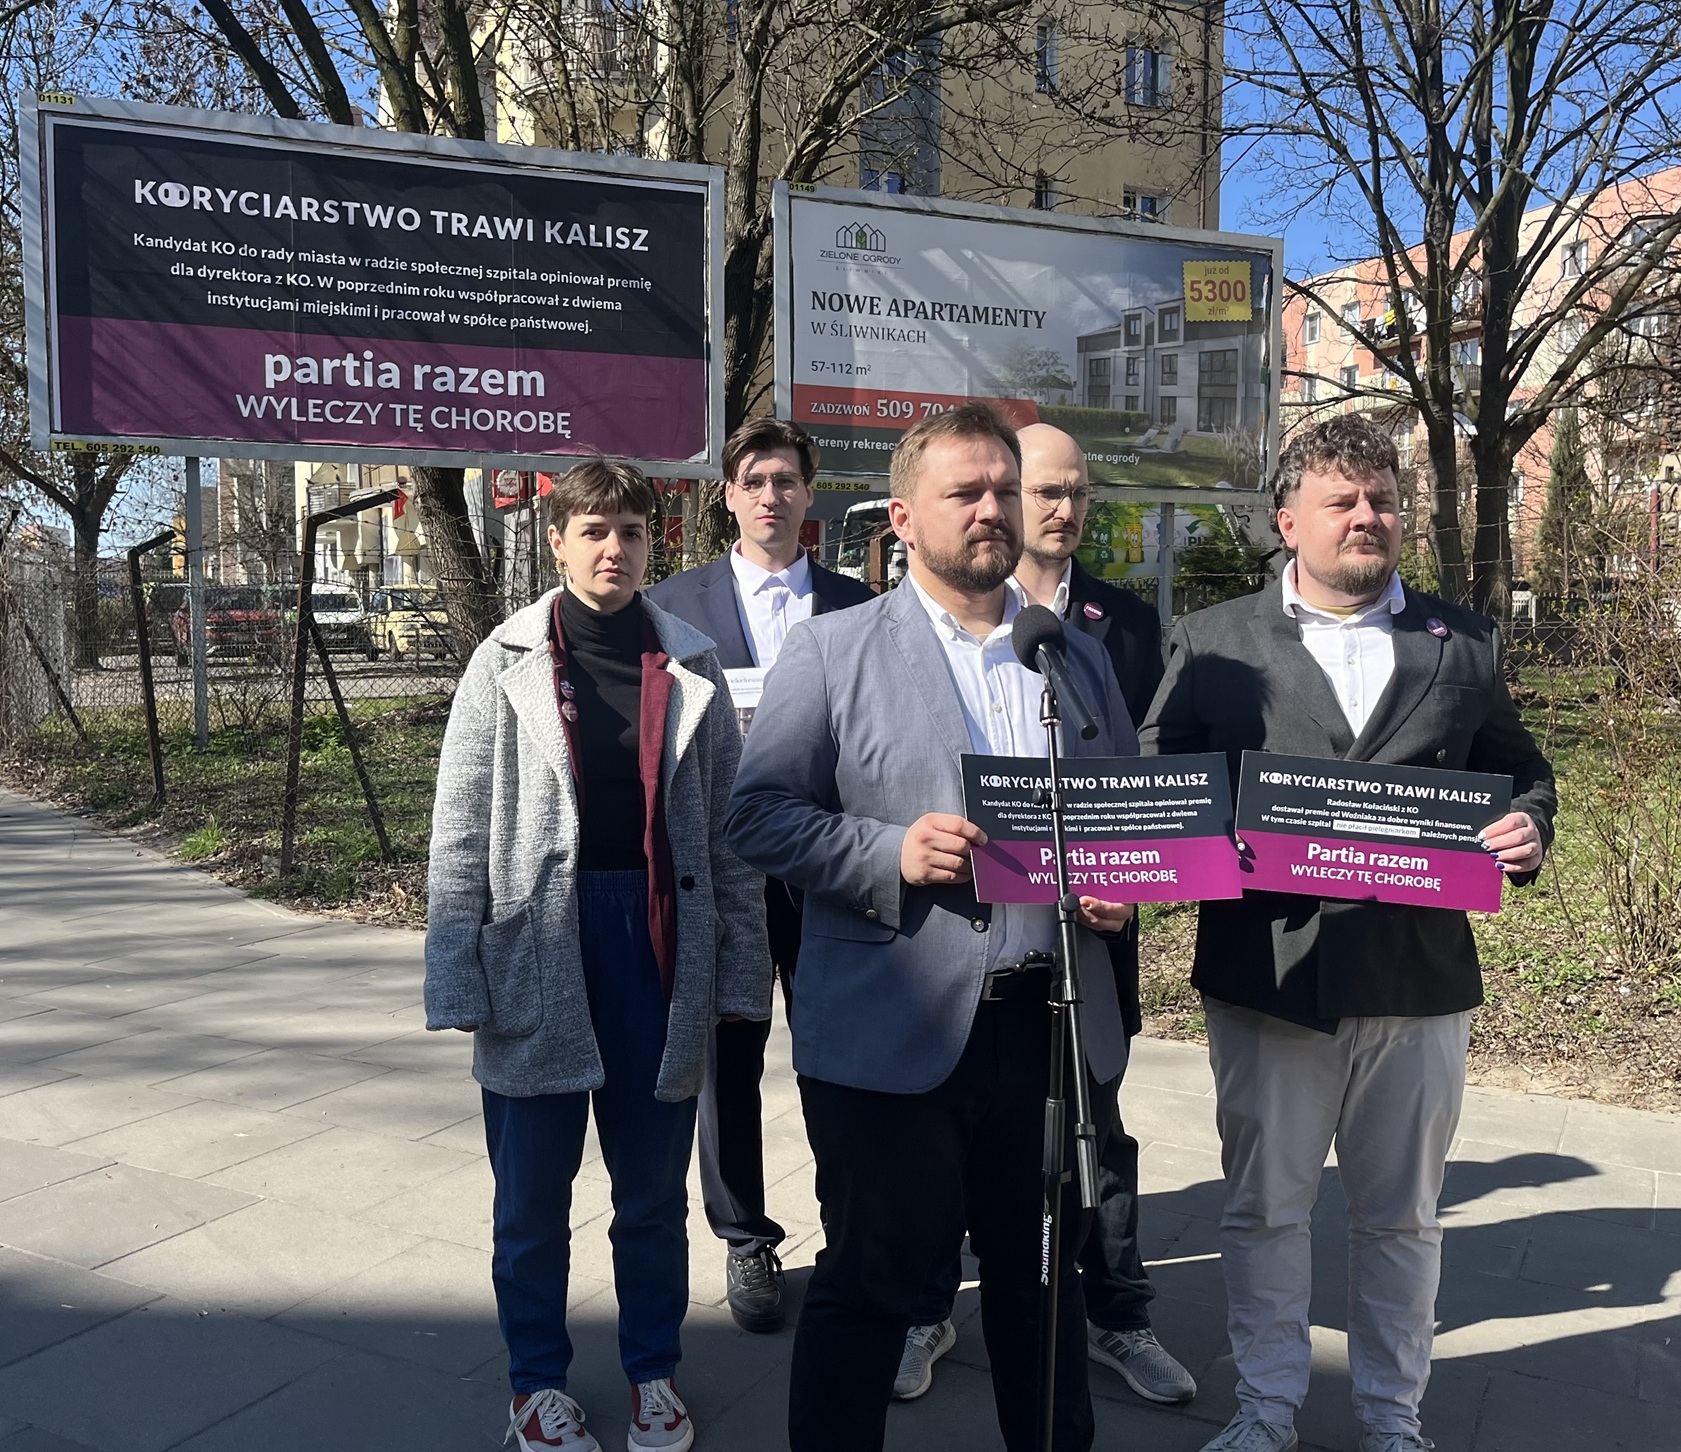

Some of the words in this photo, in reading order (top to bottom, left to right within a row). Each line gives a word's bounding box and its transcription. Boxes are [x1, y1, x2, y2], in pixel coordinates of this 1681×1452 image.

[38, 94, 75, 105] 01131
[789, 183, 815, 193] 01149
[430, 210, 534, 241] TRAWI
[544, 221, 650, 252] KALISZ
[133, 233, 207, 253] Kandydat
[211, 242, 235, 256] KO
[239, 244, 257, 258] do
[261, 247, 295, 263] rady
[298, 249, 346, 266] miasta
[349, 256, 361, 267] w
[364, 256, 408, 272] radzie
[411, 260, 483, 280] społecznej
[486, 266, 538, 283] szpitala
[540, 270, 604, 288] opiniował
[607, 276, 652, 291] premię
[820, 249, 859, 261] ZIELONE
[862, 253, 902, 265] OGRODY
[1218, 265, 1230, 275] od
[170, 262, 194, 277] dla
[197, 265, 271, 285] dyrektora
[275, 275, 283, 285] z
[286, 273, 314, 287] KO.
[317, 275, 334, 289] W
[337, 279, 420, 297] poprzednim
[423, 284, 455, 299] roku
[458, 288, 559, 306] współpracował
[562, 297, 570, 307] z
[572, 295, 622, 310] dwiema
[1189, 279, 1246, 303] 5300
[207, 291, 300, 312] instytucjami
[303, 300, 371, 320] miejskimi
[374, 304, 379, 318] i
[382, 307, 445, 324] pracował
[449, 313, 461, 324] w
[463, 312, 507, 330] spółce
[510, 315, 593, 334] państwowej.
[811, 290, 881, 316] NOWE
[886, 298, 1047, 330] APARTAMENTY
[811, 321, 827, 336] W
[830, 320, 926, 344] ŚLIWNIKACH
[264, 350, 400, 389] partia
[413, 362, 545, 397] razem
[811, 361, 852, 375] 57-112
[236, 394, 383, 426] WYLECZY
[389, 404, 424, 432] TĘ
[430, 406, 571, 439] CHOROBĘ
[810, 402, 870, 416] ZADZWOŃ
[876, 399, 914, 419] 509
[54, 441, 82, 452] TEL.
[86, 443, 109, 453] 605
[112, 444, 135, 455] 292
[138, 445, 161, 455] 540
[810, 435, 850, 451] Tereny
[1083, 451, 1104, 462] atne
[1105, 453, 1140, 466] ogrody
[816, 482, 833, 490] 605
[835, 482, 851, 491] 292
[853, 483, 870, 491] 540
[1100, 776, 1151, 789] TRAWI
[1154, 773, 1209, 788] KALISZ
[1384, 783, 1436, 800] TRAWI
[1438, 788, 1492, 806] KALISZ
[1271, 804, 1304, 815] dostawał
[1340, 811, 1377, 822] Woźniaka
[1409, 817, 1434, 828] wyniki
[1434, 820, 1473, 831] finansowe.
[1362, 801, 1400, 813] Kołaciński
[1143, 821, 1185, 832] państwowej.
[1307, 818, 1332, 829] szpital
[1421, 829, 1457, 841] należnych
[1099, 848, 1161, 865] razem
[1307, 843, 1365, 864] Partia
[1369, 852, 1429, 870] razem
[1091, 872, 1109, 887] TĘ
[1109, 869, 1179, 884] CHOROBĘ
[1290, 863, 1355, 880] WYLECZY
[1357, 871, 1373, 884] TĘ
[1374, 873, 1442, 892] CHOROBĘ
[1041, 1212, 1052, 1286] Soundking
